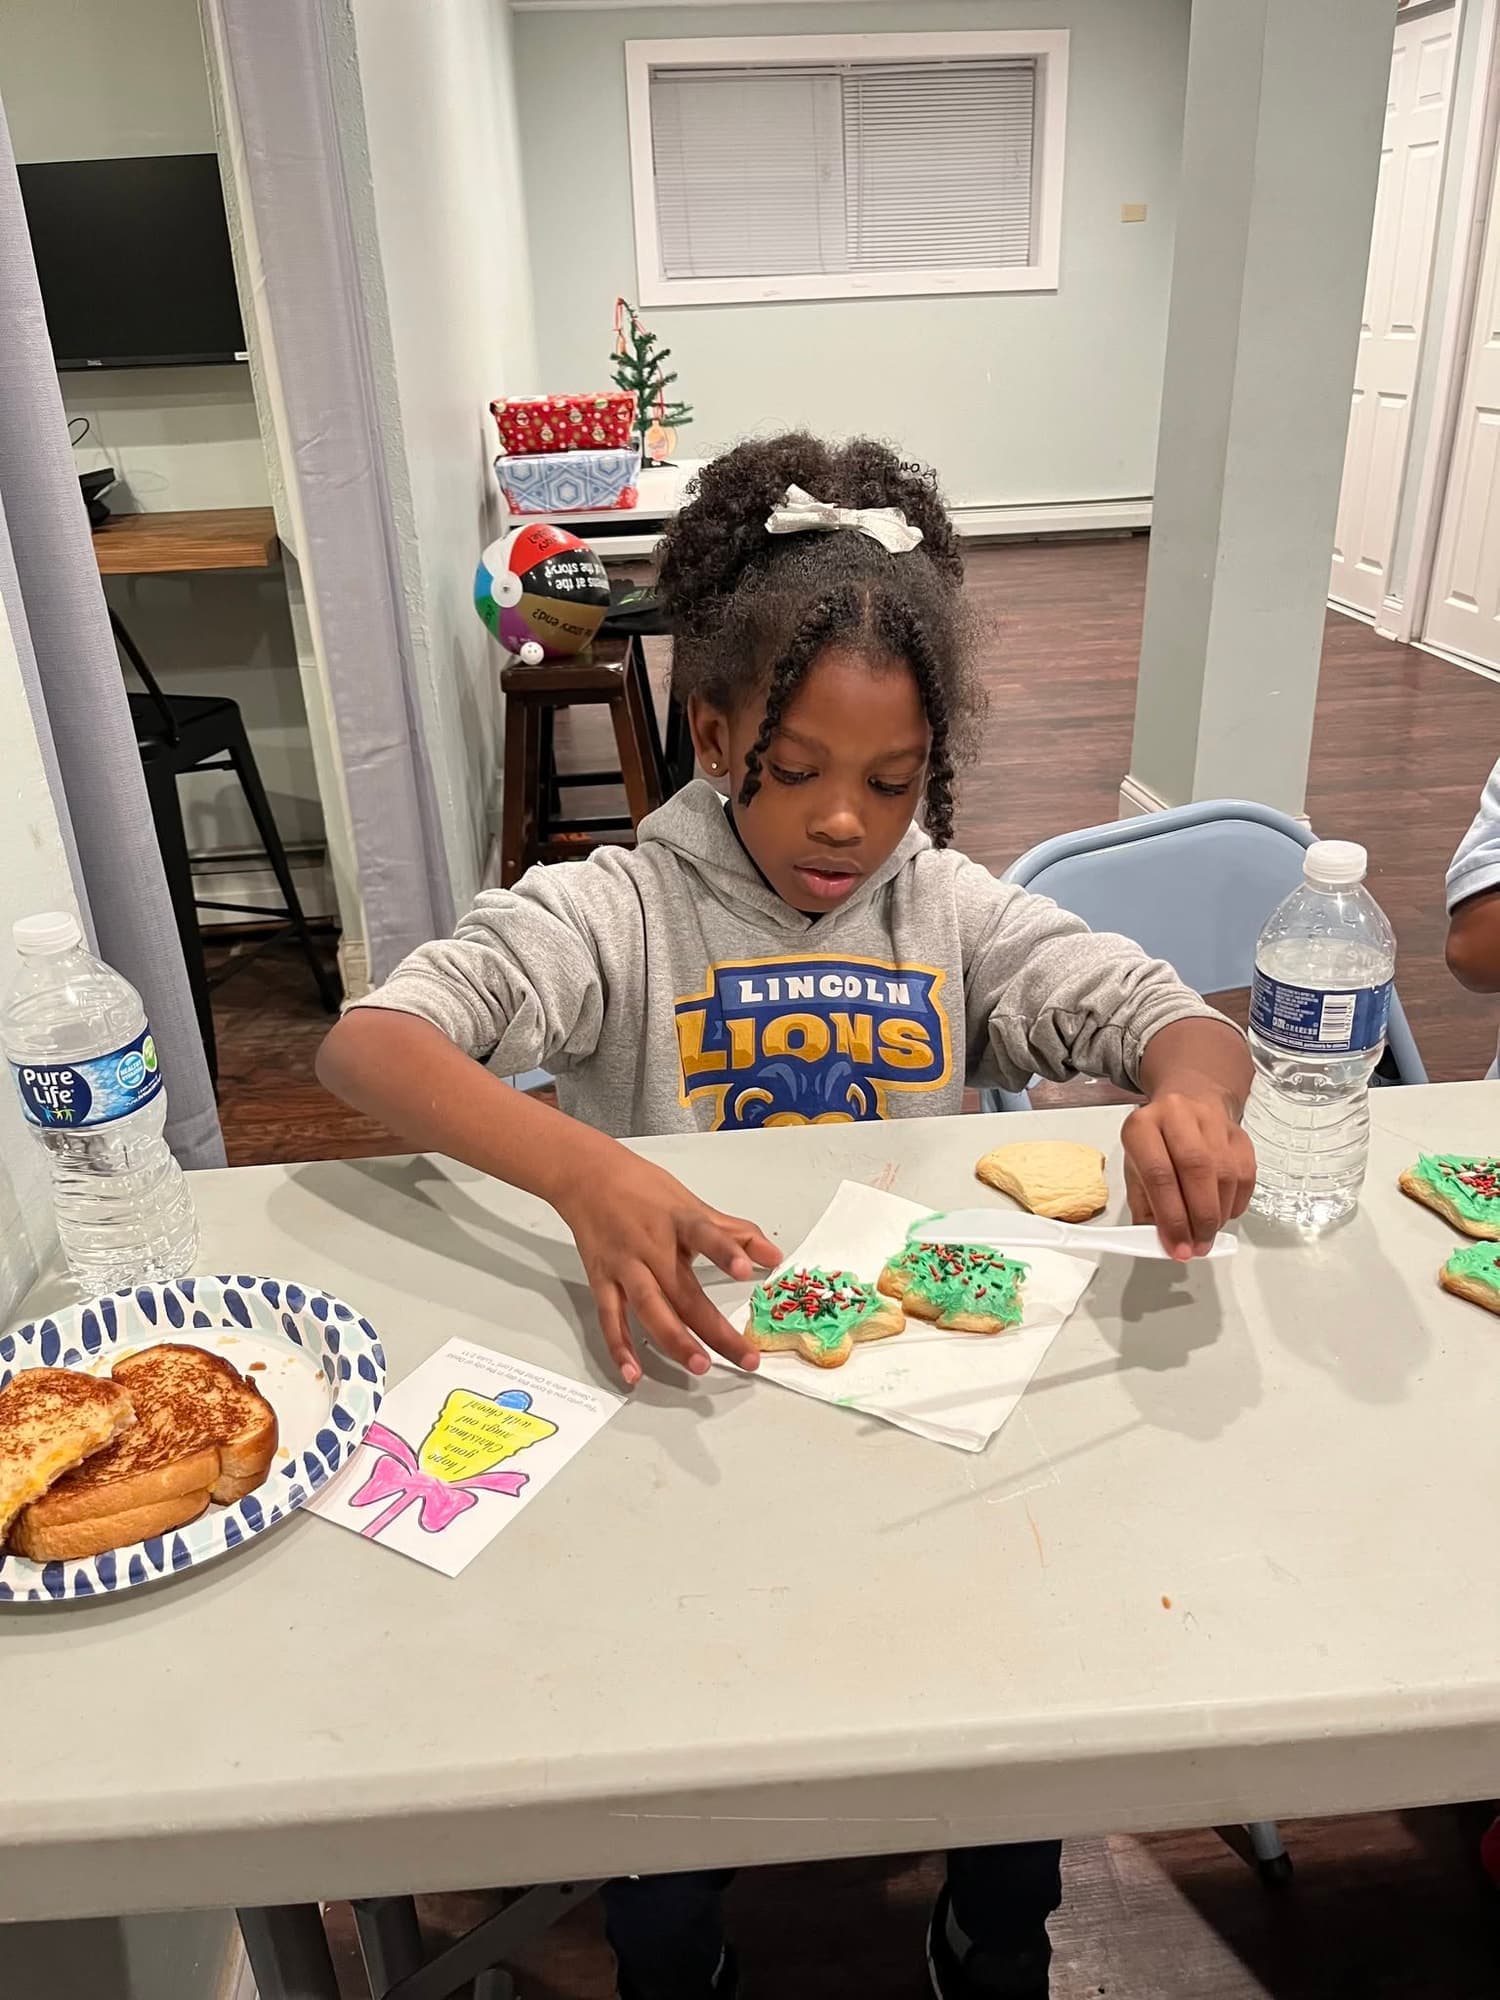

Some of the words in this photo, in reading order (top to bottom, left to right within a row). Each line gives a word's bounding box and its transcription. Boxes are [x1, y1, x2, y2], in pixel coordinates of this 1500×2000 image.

[555, 578, 574, 591] the
[532, 608, 559, 627] end?
[738, 974, 911, 1006] LINCOLN
[675, 1009, 935, 1078] LIONS
[23, 1069, 74, 1086] Pure
[32, 1086, 73, 1108] Life
[454, 1415, 479, 1426] out
[500, 1414, 532, 1428] with
[443, 1424, 504, 1453] Christmas
[480, 1423, 514, 1439] rings
[443, 1443, 480, 1459] your
[427, 1453, 458, 1471] hope
[452, 1465, 467, 1475] I
